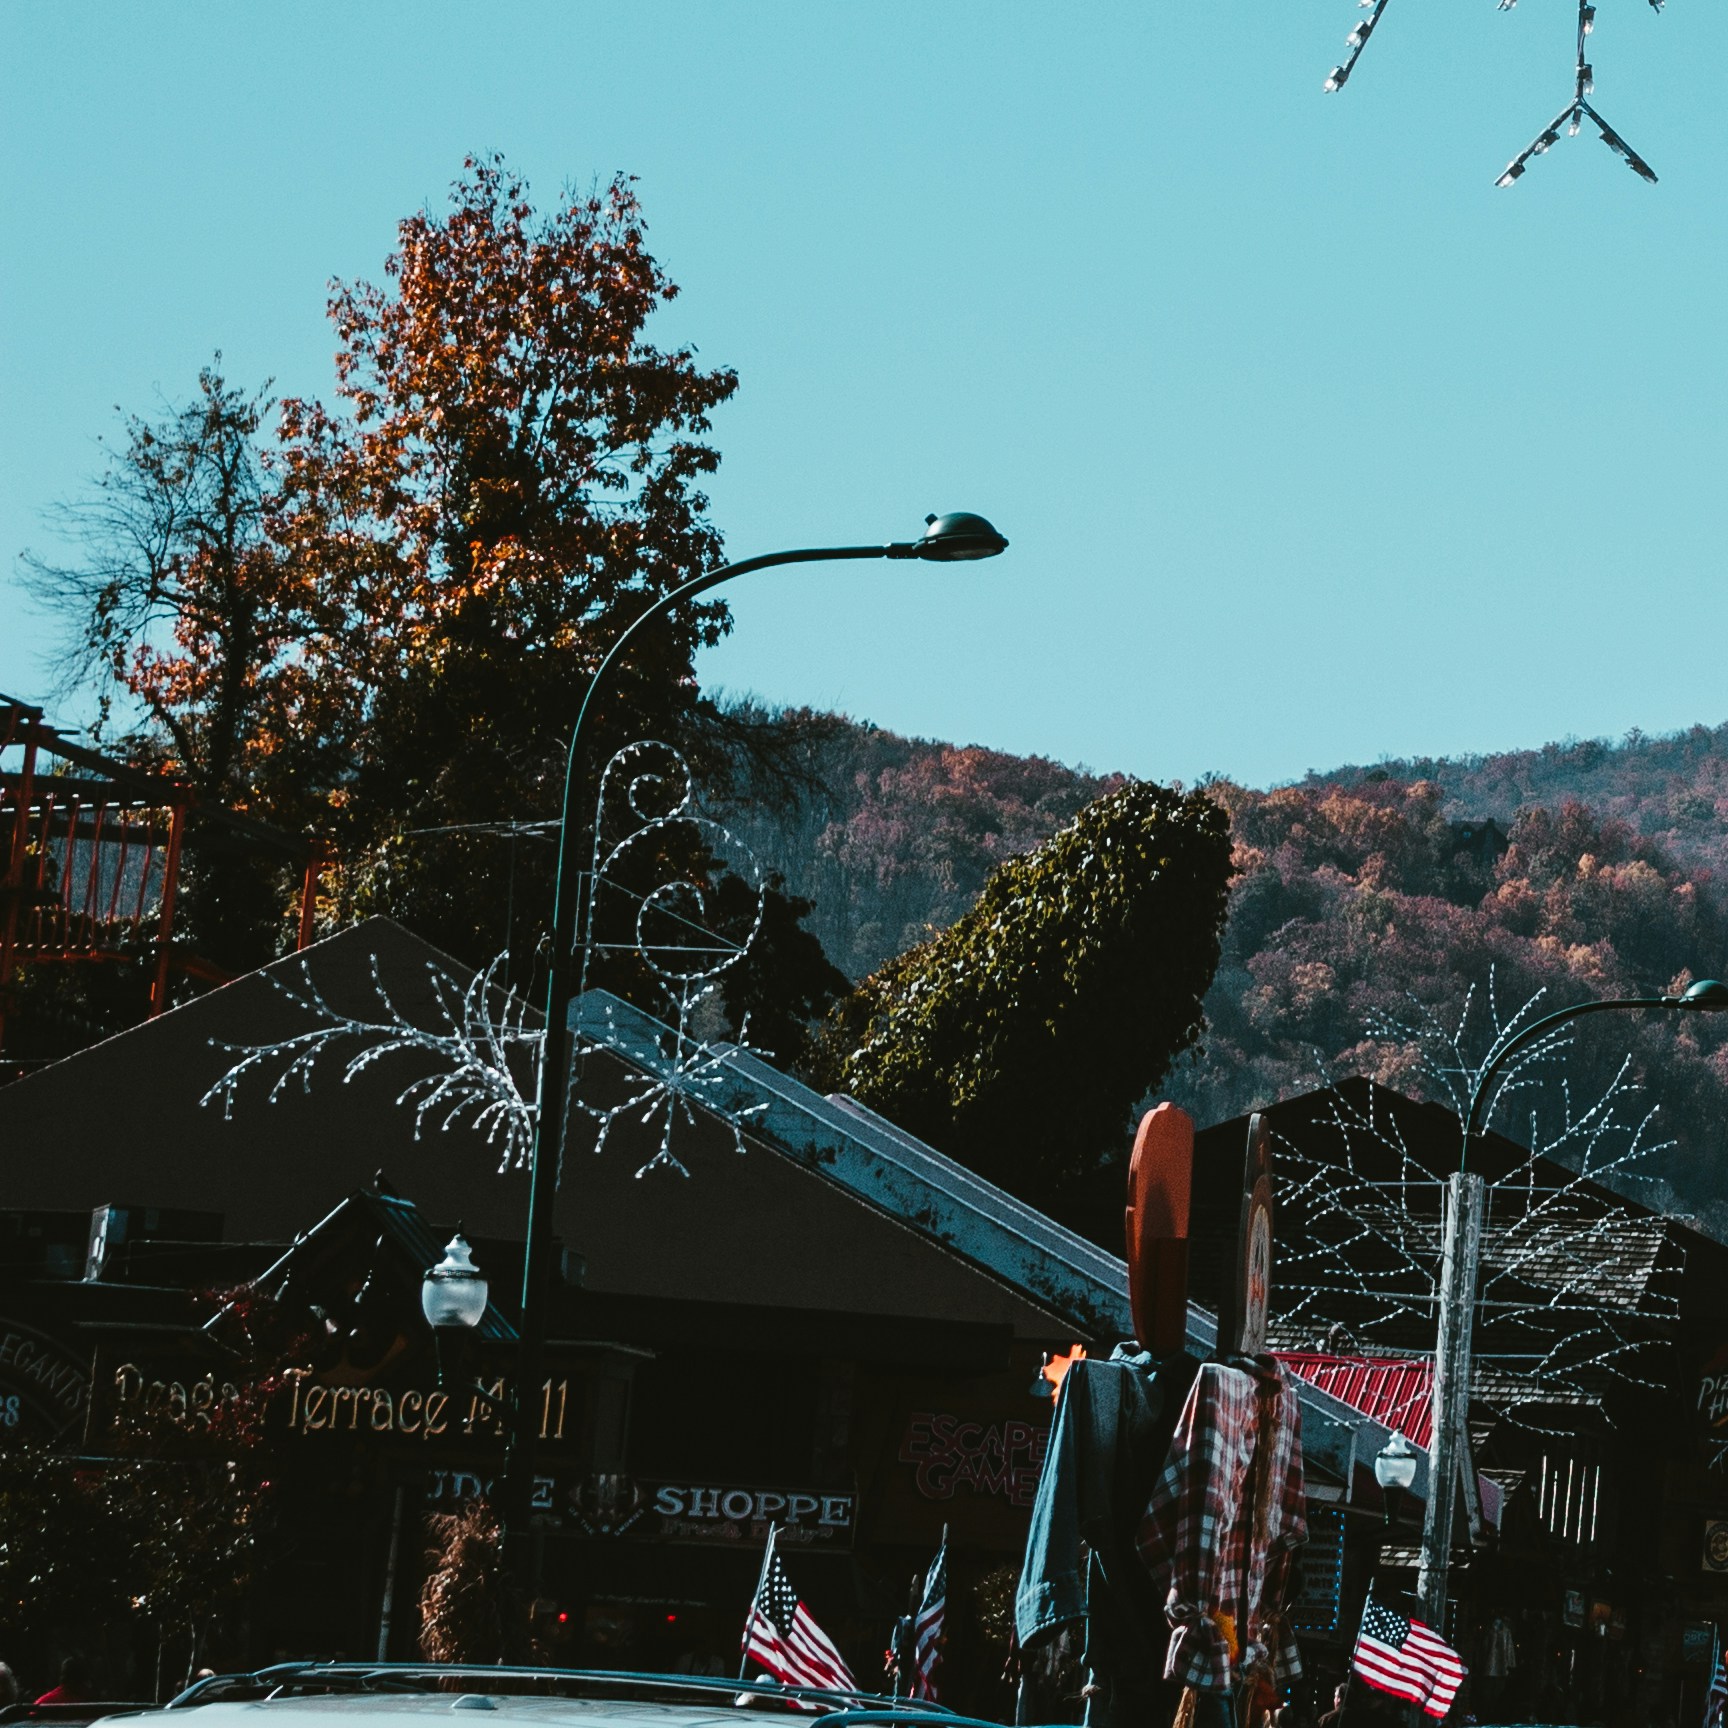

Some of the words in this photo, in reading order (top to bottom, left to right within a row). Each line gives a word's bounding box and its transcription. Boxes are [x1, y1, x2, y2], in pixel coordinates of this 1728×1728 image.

[282, 1363, 450, 1441] Terrace
[462, 1376, 568, 1439] Mll
[898, 1411, 1050, 1463] ESCAPE
[652, 1484, 853, 1528] SHOPPE
[916, 1454, 1043, 1506] GAME
